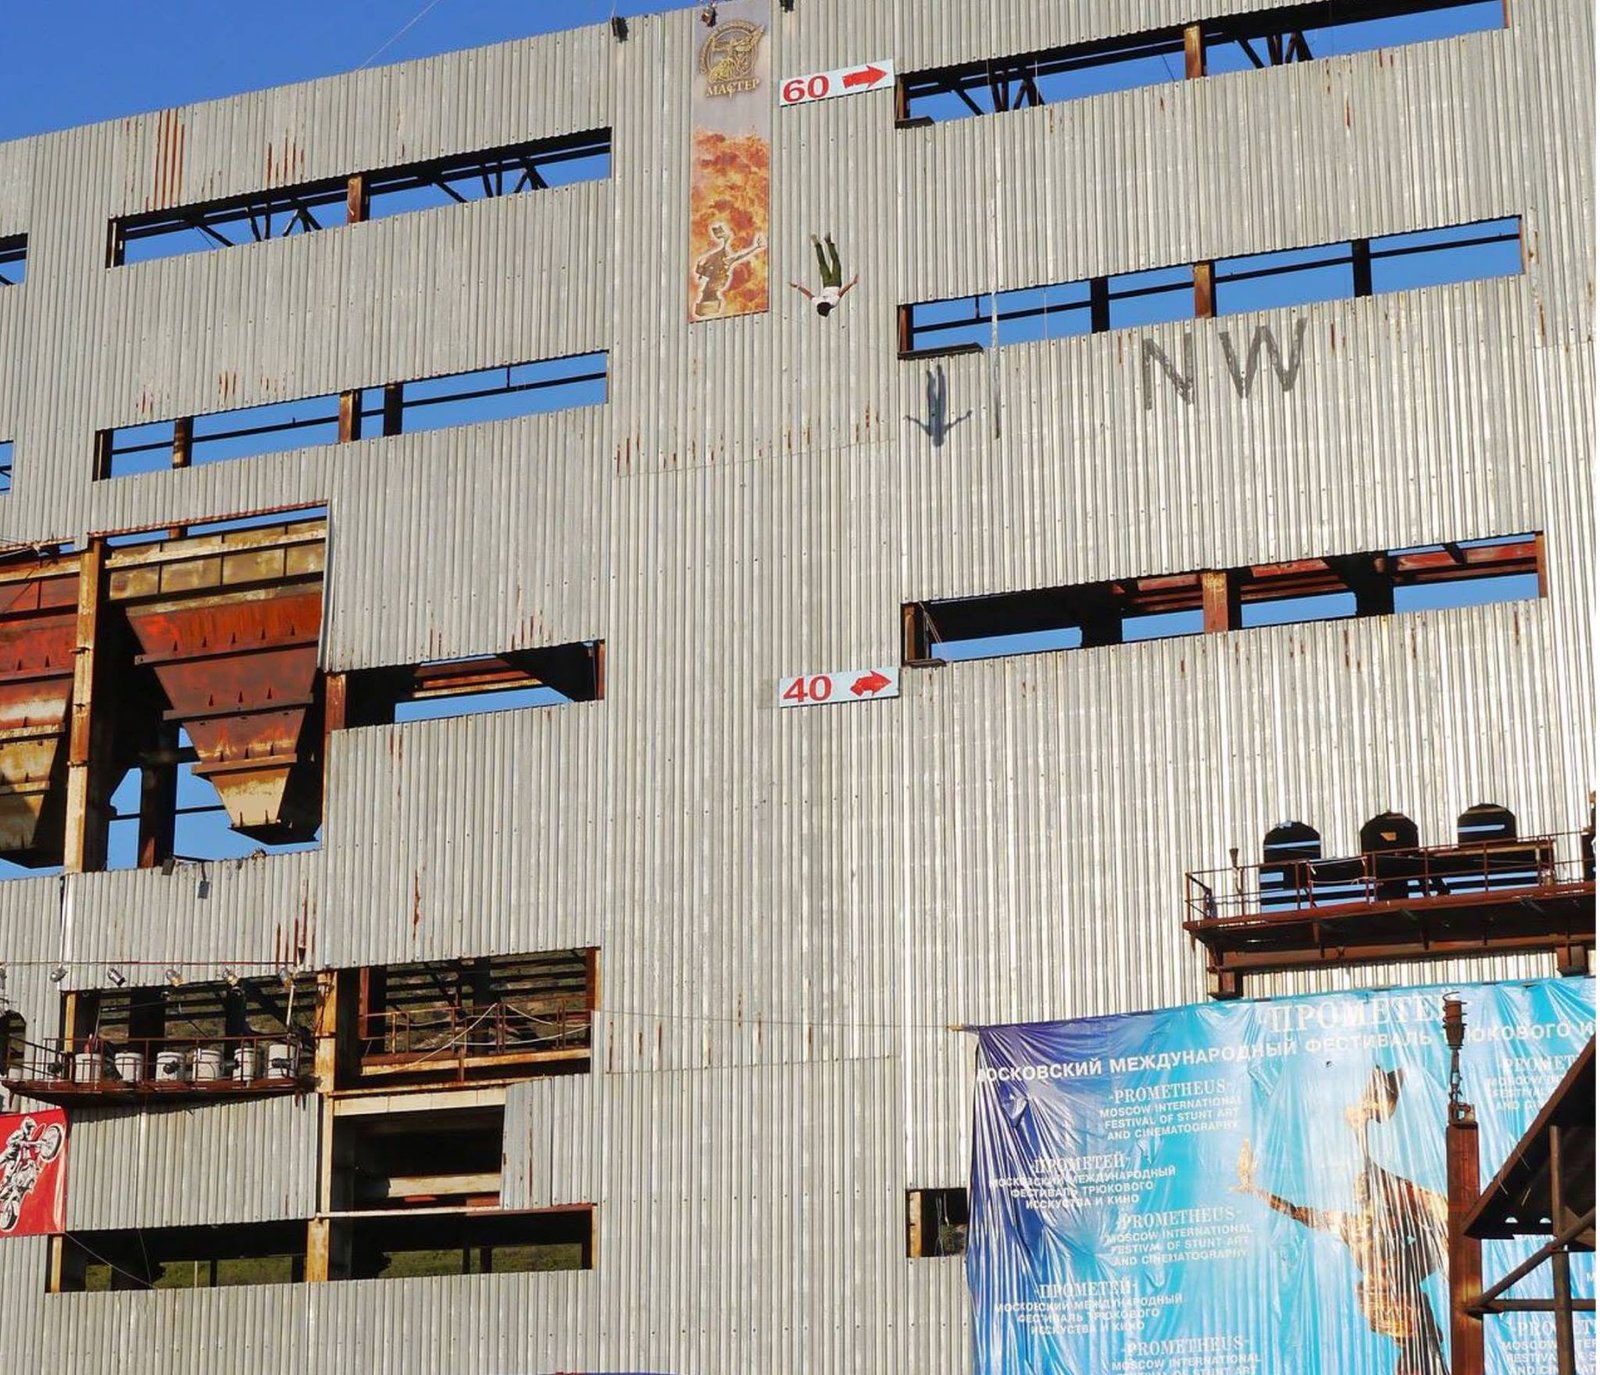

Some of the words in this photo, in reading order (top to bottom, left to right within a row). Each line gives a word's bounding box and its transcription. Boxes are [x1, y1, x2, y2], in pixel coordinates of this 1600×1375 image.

[783, 75, 830, 103] 60
[783, 675, 832, 702] 40
[1110, 1035, 1297, 1073] МЕЖДУНАРОДНЫЙ
[1305, 1031, 1433, 1051] ФЕСТИВАЛЬ
[1101, 1105, 1151, 1118] MOSCOW
[1155, 1096, 1242, 1113] INTERNATIONAL
[1105, 1115, 1156, 1129] FESTIVAL
[1160, 1114, 1174, 1124] OF
[1178, 1110, 1213, 1122] STUNT
[1217, 1107, 1240, 1118] ART
[1107, 1130, 1131, 1140] AND
[1135, 1120, 1238, 1138] CINEMATOGRAPHY
[1069, 1165, 1176, 1184] МЕЖДУНАРОДНЫЙ
[1083, 1181, 1154, 1195] ТРЮКОВОГО
[1107, 1194, 1140, 1205] КИНО
[1105, 1231, 1158, 1245] MOSCOW
[1162, 1224, 1253, 1238] INTERNATIONAL
[1167, 1241, 1181, 1250] OF
[1185, 1237, 1222, 1249] STUNT
[1227, 1235, 1250, 1246] ART
[1112, 1256, 1137, 1267] AND
[1142, 1248, 1248, 1265] CINEMATOGRAPHY
[1111, 1359, 1164, 1371] MOSCOW
[1169, 1353, 1261, 1369] INTERNATIONAL
